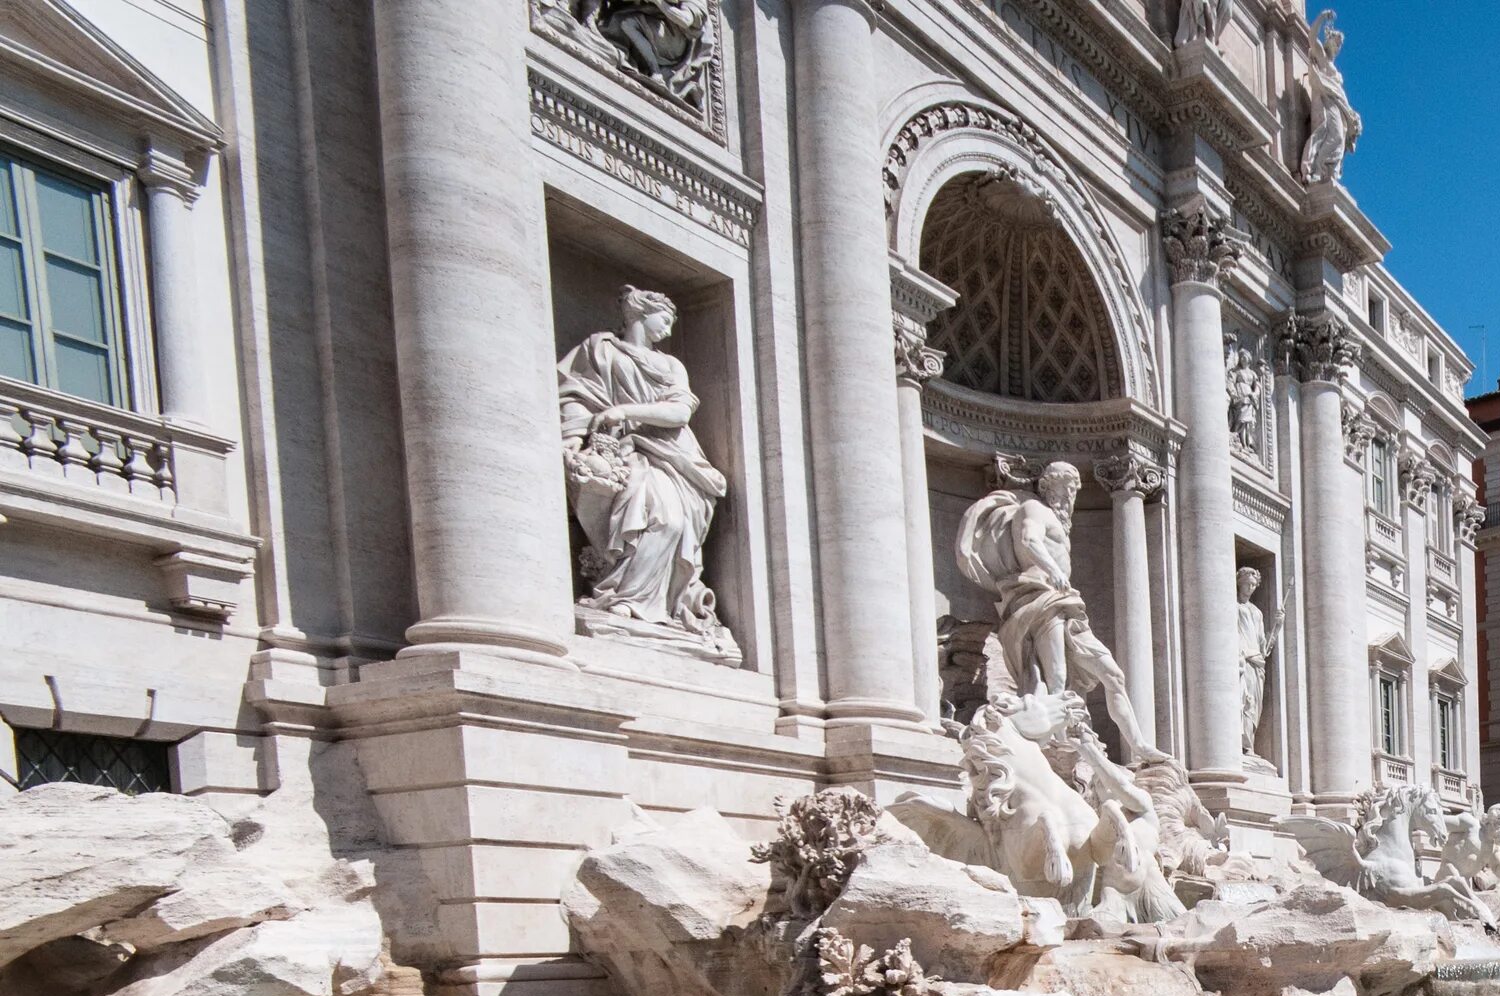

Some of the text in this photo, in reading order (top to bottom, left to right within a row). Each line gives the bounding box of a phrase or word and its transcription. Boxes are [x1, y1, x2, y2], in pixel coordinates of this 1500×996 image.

[604, 155, 662, 199] SIGNIS
[674, 190, 694, 216] ET
[709, 214, 749, 246] ANA
[1037, 439, 1071, 452] OPVS
[1076, 439, 1105, 452] CVM
